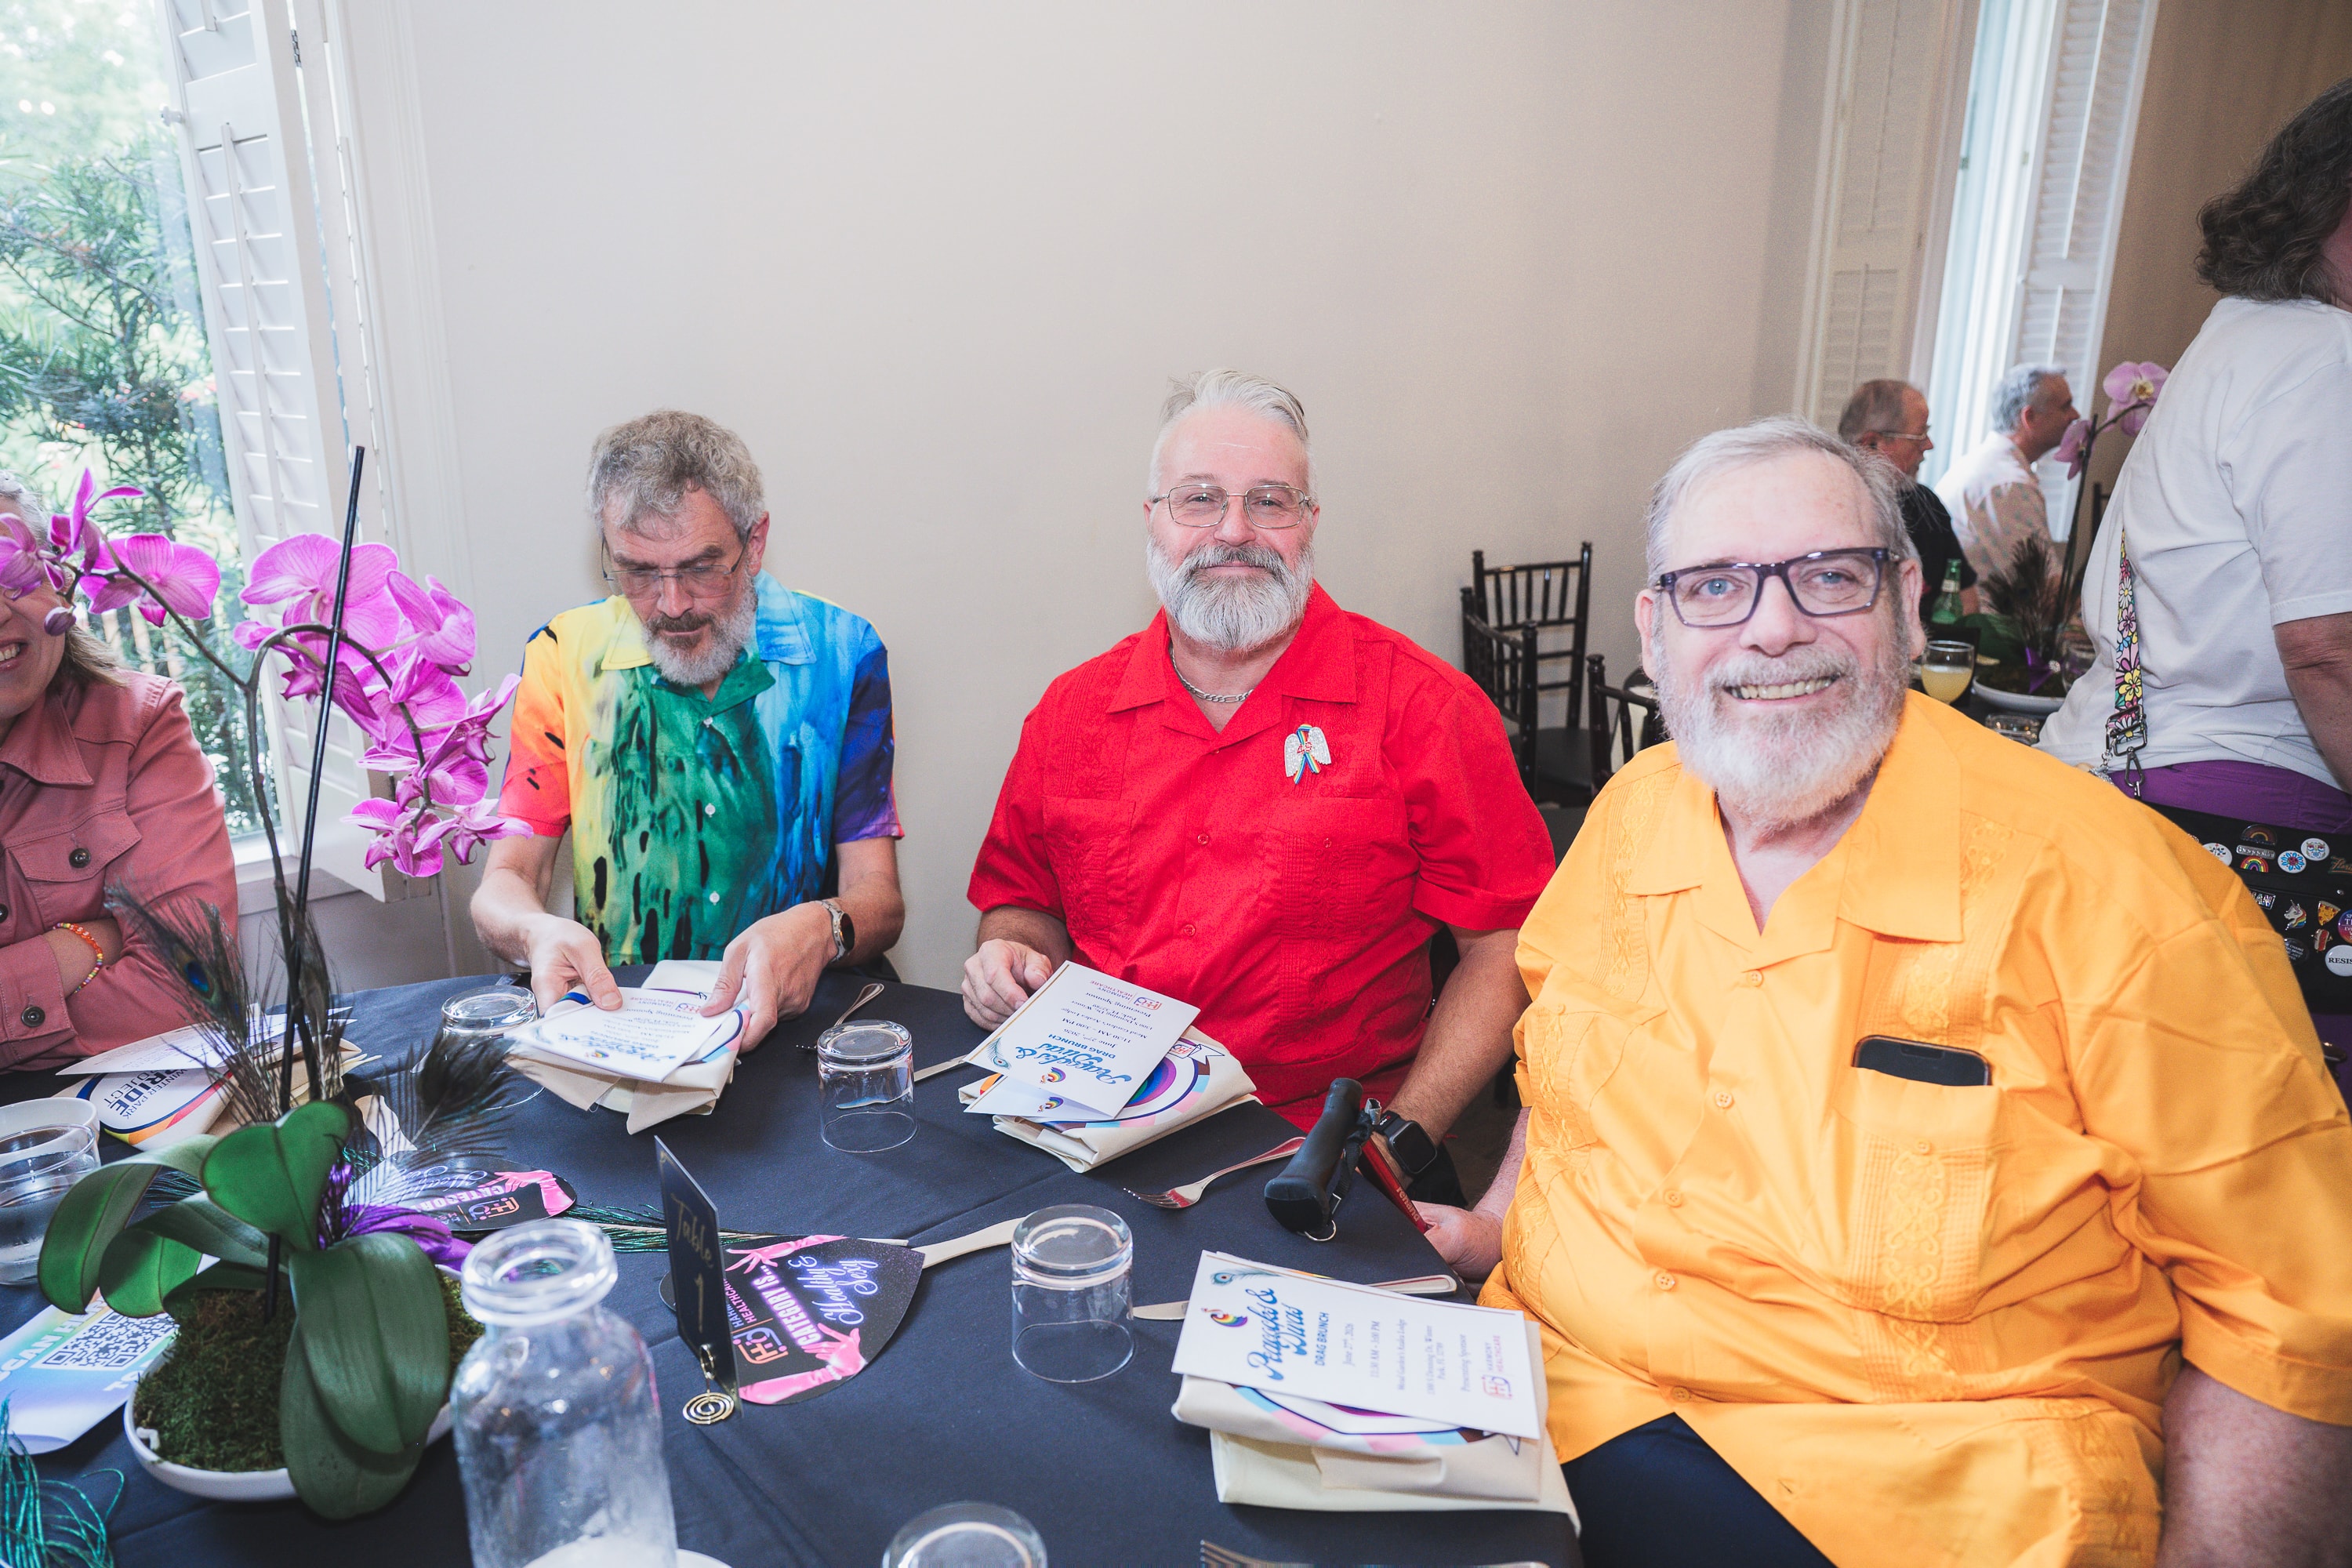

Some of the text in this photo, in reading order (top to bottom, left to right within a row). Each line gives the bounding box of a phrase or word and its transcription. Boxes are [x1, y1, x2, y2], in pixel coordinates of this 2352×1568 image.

[1091, 980, 1133, 997] HEALTHCARE
[1098, 987, 1131, 1000] HARMONY
[1061, 1007, 1080, 1017] Lodge
[1072, 1000, 1092, 1011] Winter
[1086, 992, 1151, 1018] Presenting Sponsor
[1081, 1014, 1101, 1023] Azalea
[1048, 1033, 1116, 1059] DRAG BRUNCH
[1098, 1040, 1118, 1048] June
[1113, 1035, 1131, 1044] 11:30
[1130, 1030, 1148, 1039] Mead
[1015, 1047, 1132, 1084] Peacocks &
[1035, 1043, 1104, 1064] Divas
[104, 1070, 157, 1108] OJECT
[122, 1069, 188, 1120] WINTER PARK
[670, 1192, 714, 1269] Table
[787, 1255, 865, 1325] Healthy &
[836, 1259, 879, 1295] Sexy
[695, 1272, 704, 1334] 1
[761, 1287, 822, 1346] CATEGORY
[1277, 1302, 1307, 1356] Divas
[1370, 1320, 1380, 1331] PM
[1245, 1288, 1284, 1380] Peacocks &
[1315, 1312, 1330, 1366] DRAG BRUNCH
[1342, 1351, 1356, 1367] June
[1370, 1348, 1379, 1359] AM
[1458, 1334, 1472, 1392] Presenting Sponsor
[1493, 1335, 1504, 1372] HEALTHCARE
